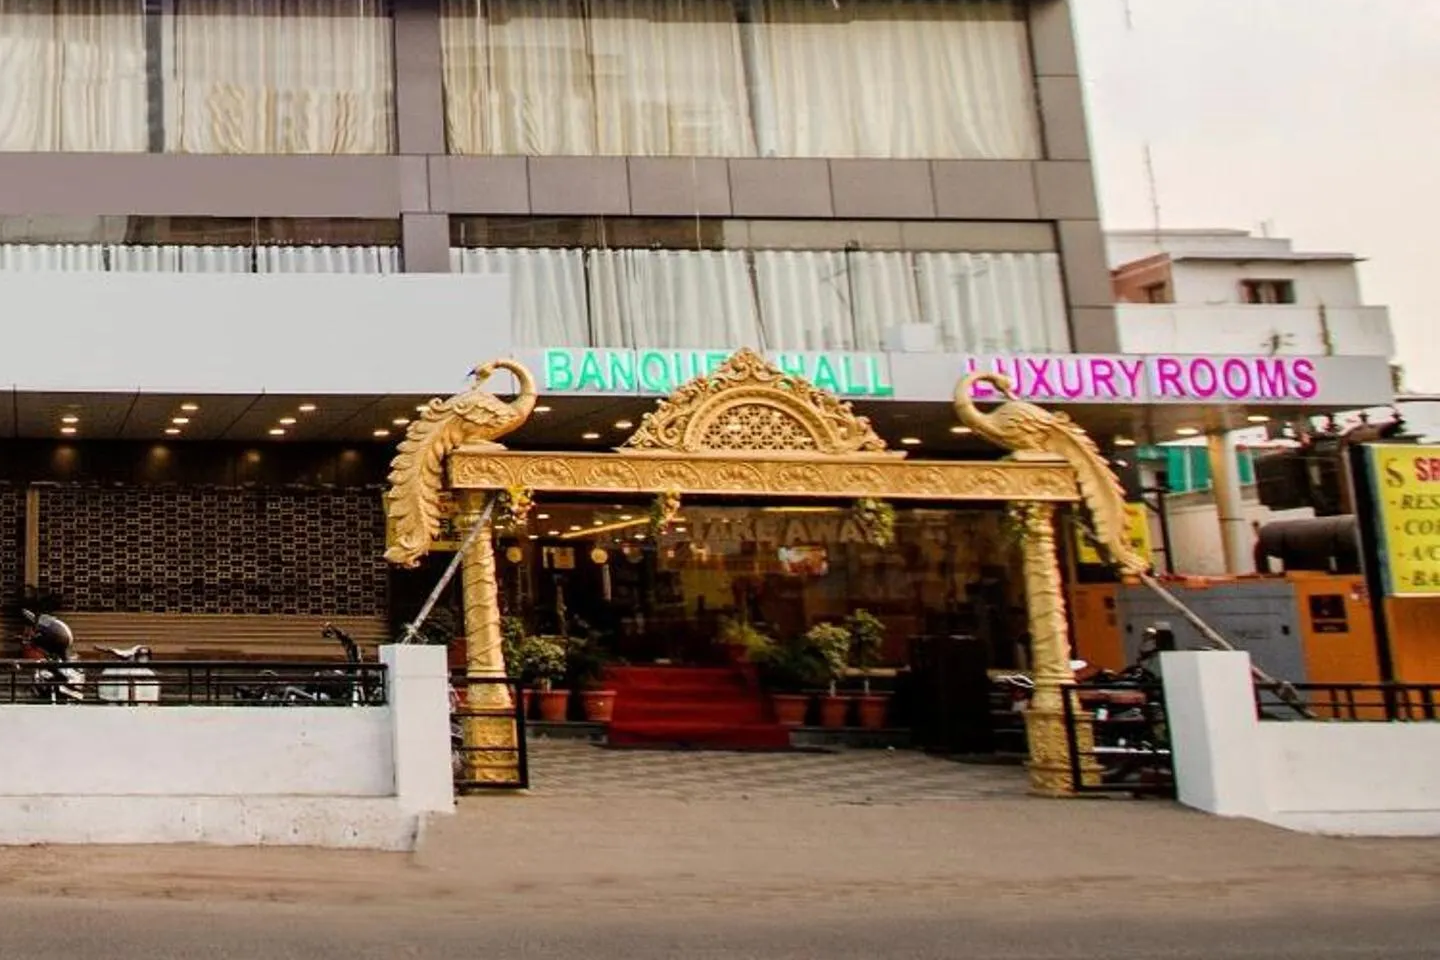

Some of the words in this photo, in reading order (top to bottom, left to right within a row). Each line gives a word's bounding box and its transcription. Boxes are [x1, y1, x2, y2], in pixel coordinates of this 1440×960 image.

[545, 349, 732, 392] BANQU
[780, 353, 895, 396] HALL
[967, 358, 1143, 398] LUXURY
[1156, 357, 1318, 399] ROOMS
